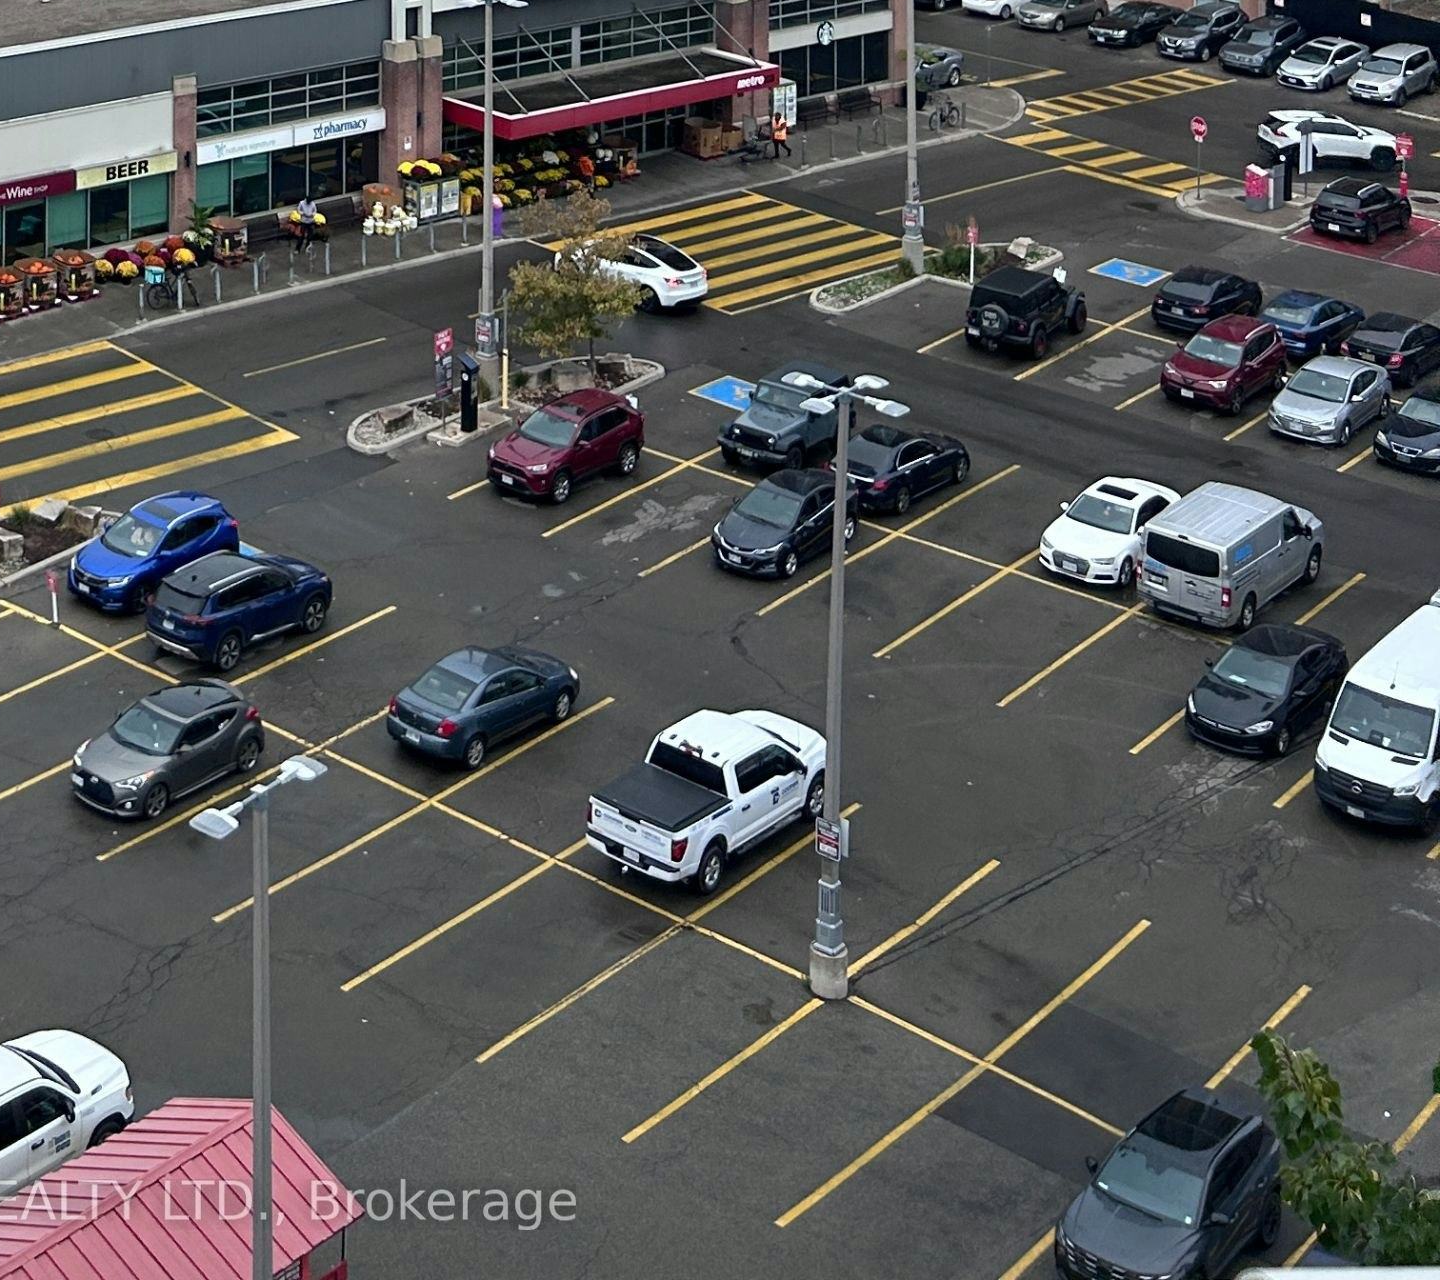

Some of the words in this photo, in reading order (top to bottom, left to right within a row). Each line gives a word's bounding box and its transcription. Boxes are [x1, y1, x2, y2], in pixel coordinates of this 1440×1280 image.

[737, 75, 765, 89] metro
[324, 118, 368, 137] pharmacy
[106, 159, 149, 181] BEER
[6, 185, 33, 200] Wine
